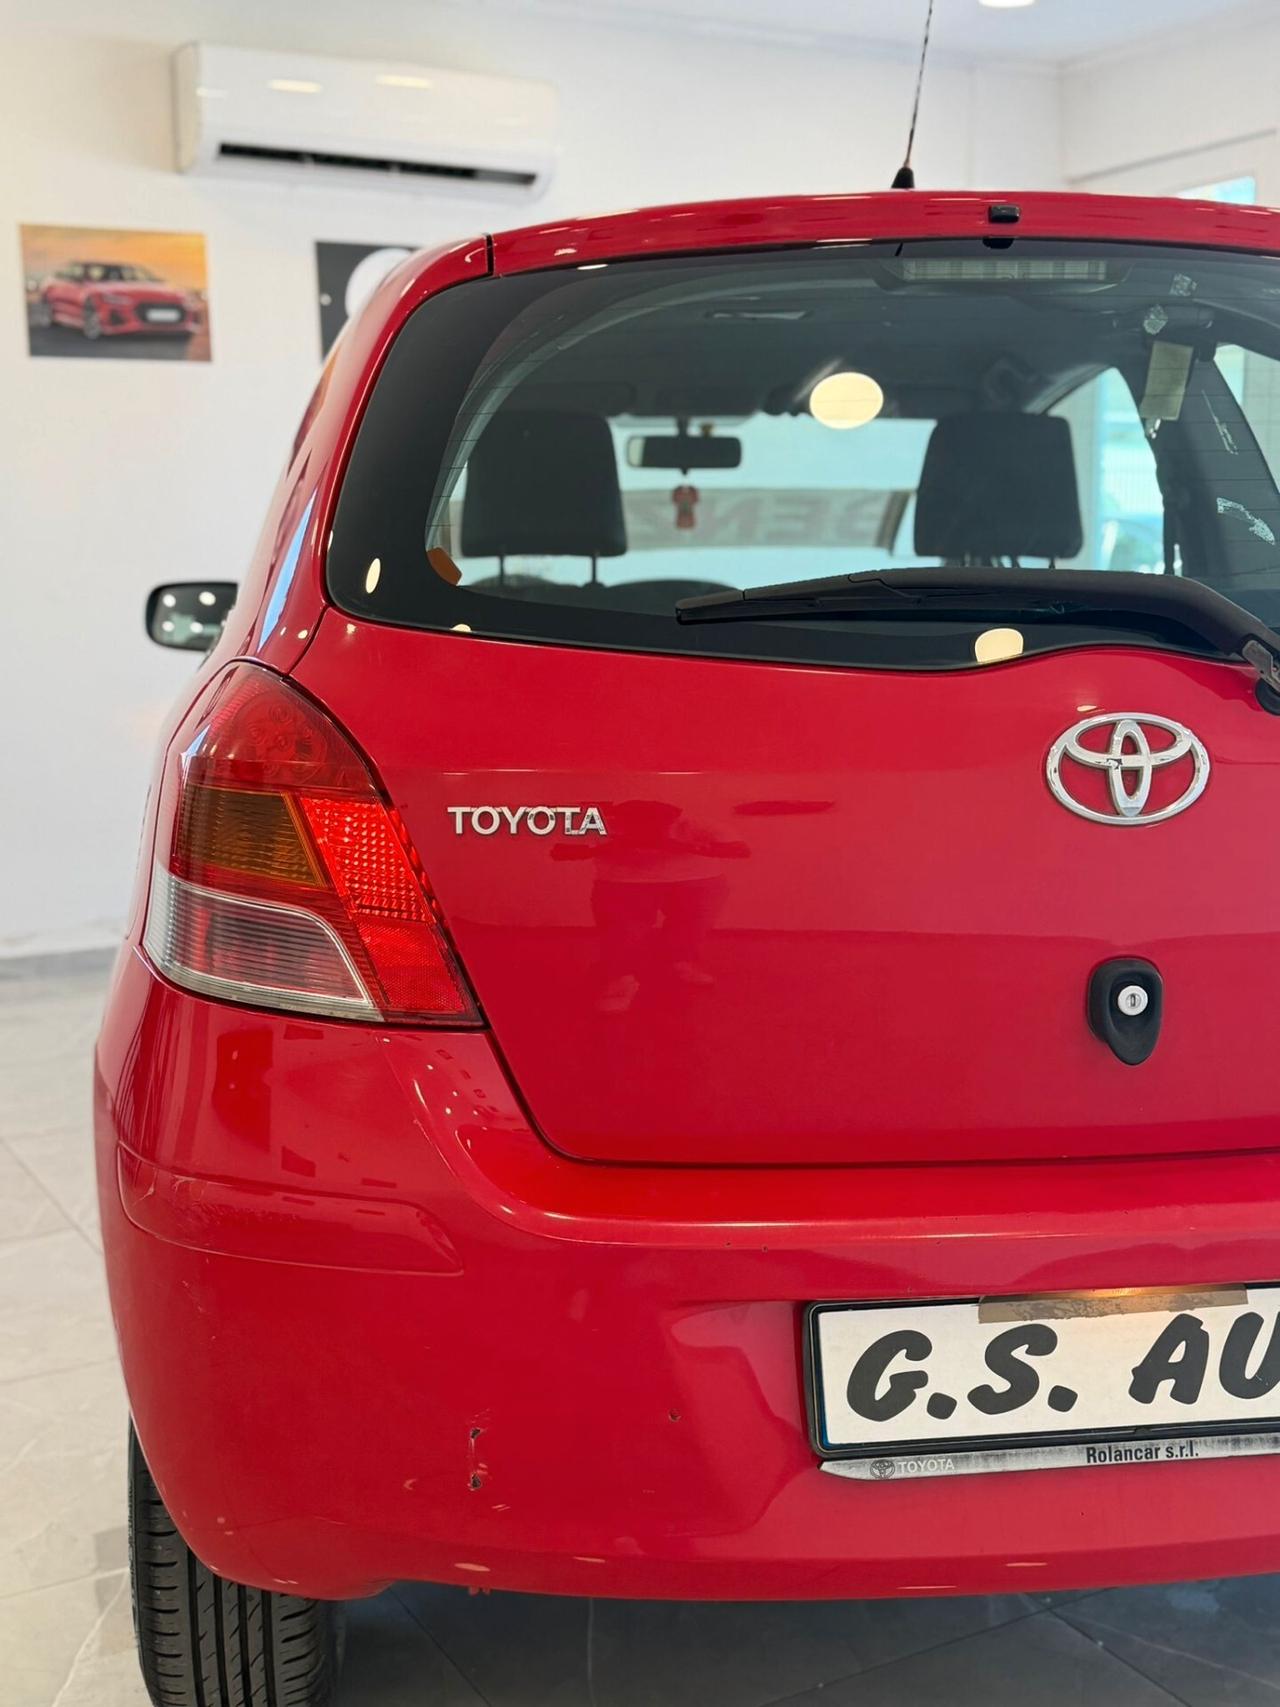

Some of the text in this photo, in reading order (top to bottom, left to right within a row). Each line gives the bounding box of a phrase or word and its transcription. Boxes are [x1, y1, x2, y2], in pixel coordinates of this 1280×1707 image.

[447, 805, 608, 836] TOYOTA
[845, 1312, 1280, 1422] G.S. AU
[1085, 1439, 1199, 1464] Rolancar s.r.l.
[897, 1458, 956, 1474] TOYOTA
